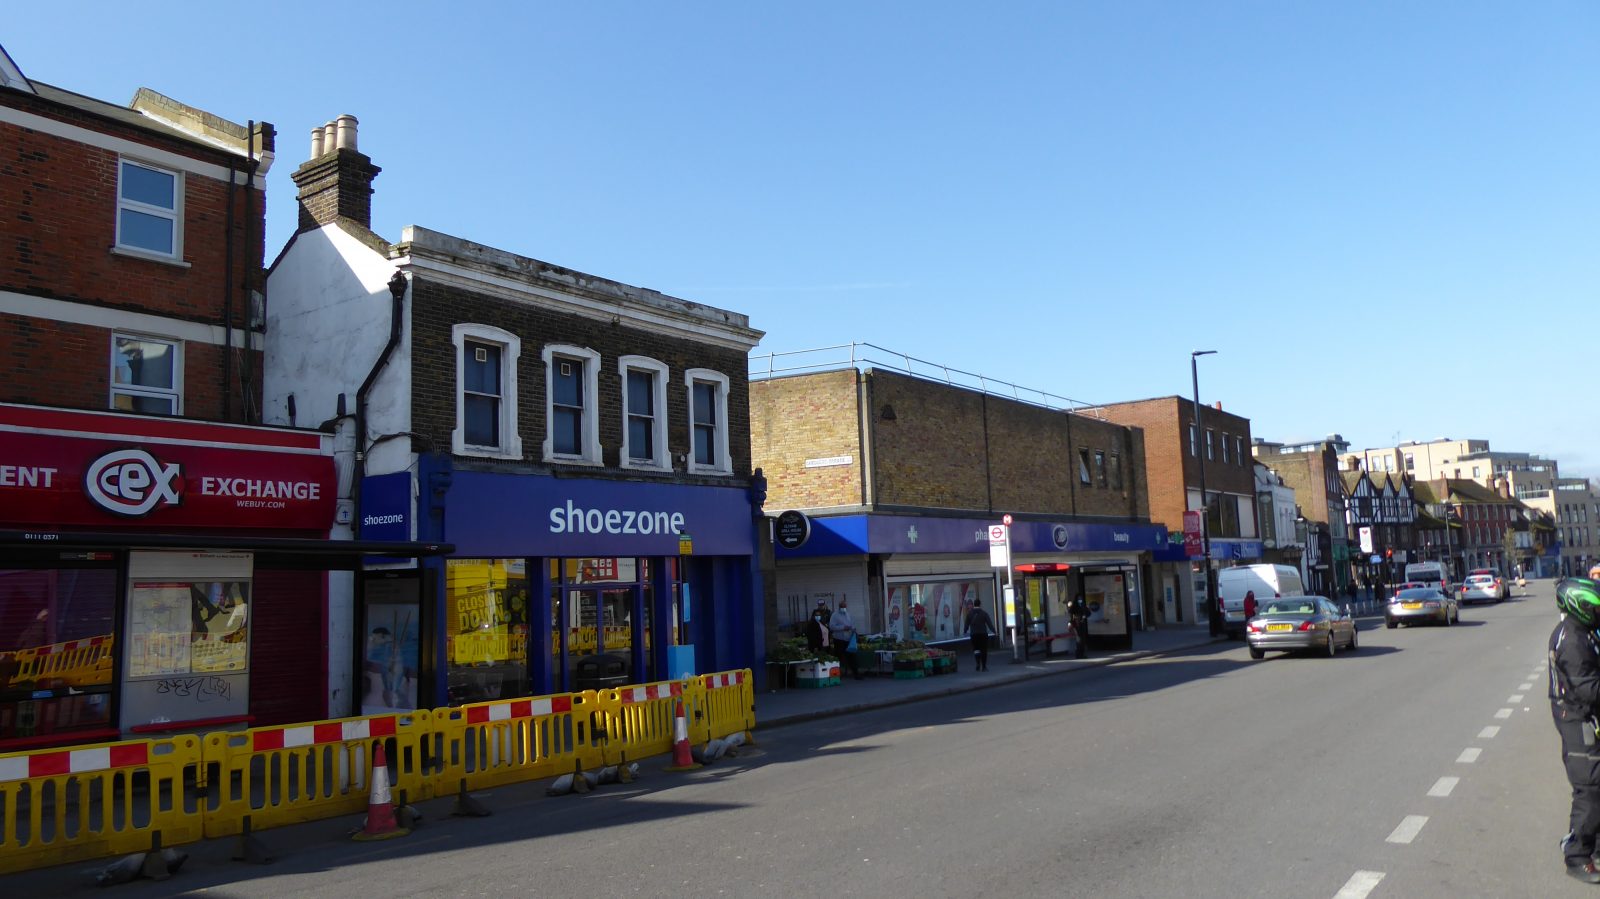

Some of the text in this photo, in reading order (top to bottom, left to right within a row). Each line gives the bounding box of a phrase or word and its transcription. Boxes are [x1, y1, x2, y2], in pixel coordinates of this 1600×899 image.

[201, 477, 321, 501] EXCHANGE
[236, 500, 286, 509] WEBUY.COM
[364, 513, 404, 526] shoezone
[550, 499, 685, 535] shoezone
[459, 605, 505, 631] DOWN
